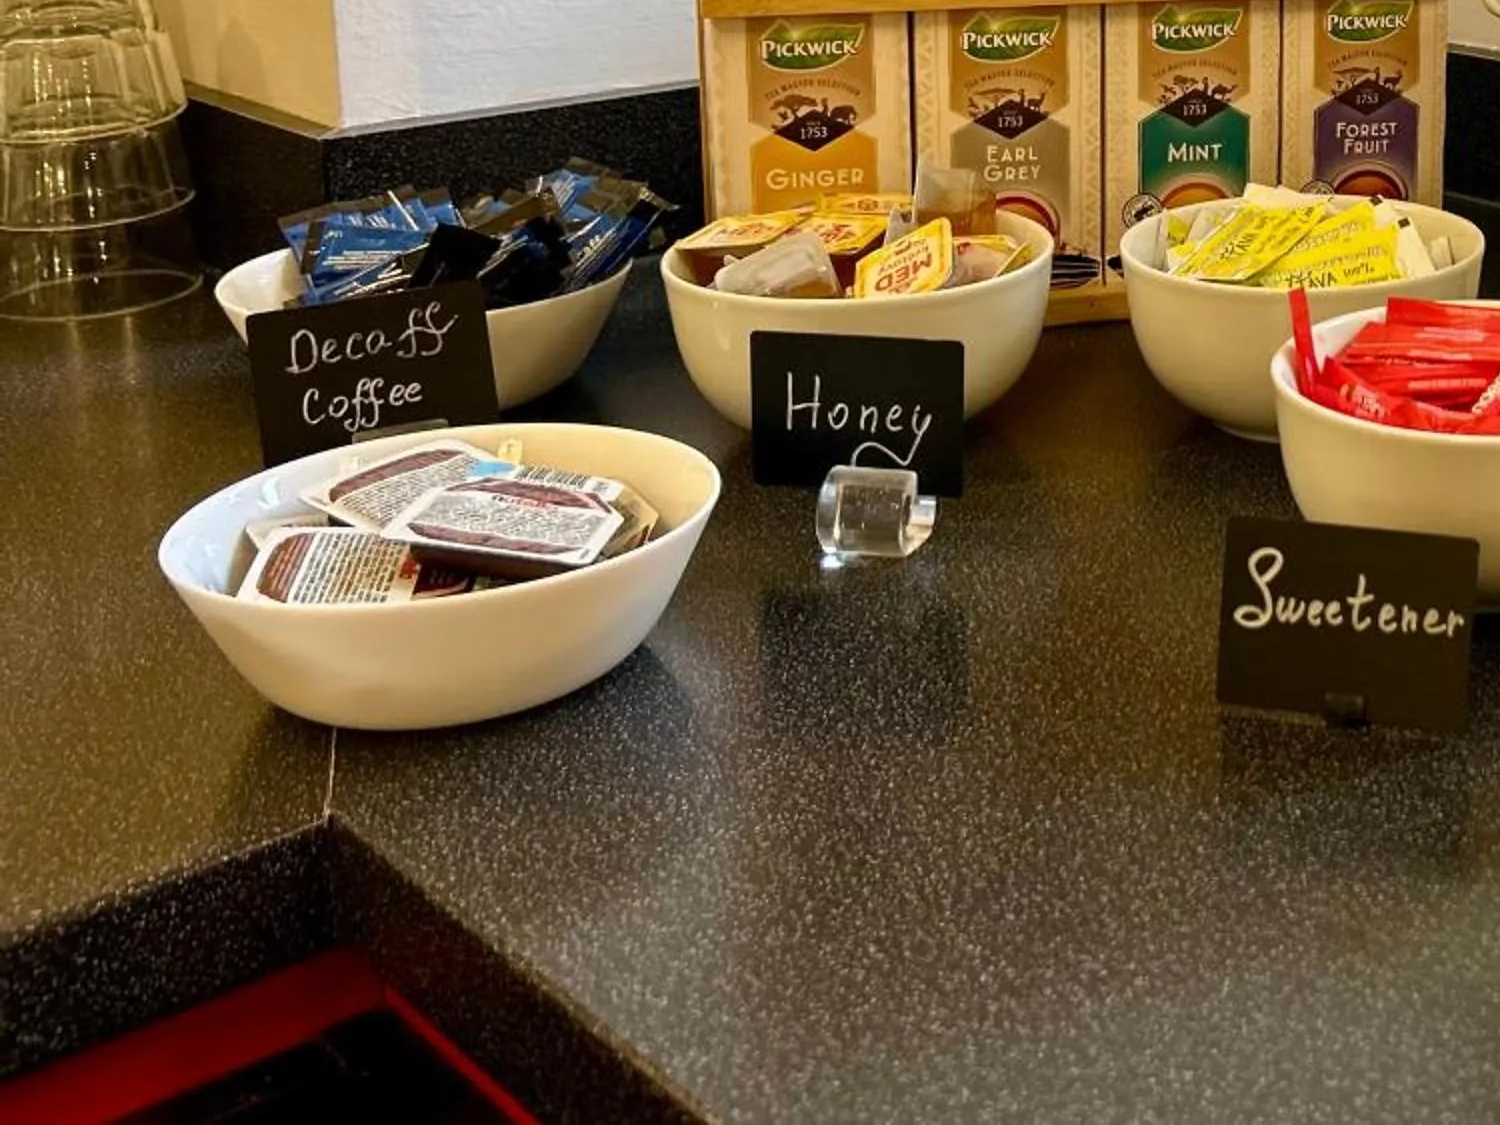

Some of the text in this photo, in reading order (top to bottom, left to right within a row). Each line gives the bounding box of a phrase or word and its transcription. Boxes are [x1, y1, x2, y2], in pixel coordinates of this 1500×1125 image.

[1151, 22, 1235, 41] PICKWICK
[1327, 13, 1407, 33] PICKWICK
[761, 39, 857, 60] PICKWICK
[962, 31, 1053, 50] PICKWICK
[800, 126, 829, 140] 1753
[1335, 121, 1398, 138] FOREST
[986, 145, 1038, 162] EARL
[1167, 142, 1223, 163] MINT
[1343, 138, 1390, 156] FRUIT
[765, 168, 865, 190] GINGER
[983, 163, 1041, 183] GREY
[285, 301, 459, 374] Decaff
[302, 378, 423, 432] Coffee
[785, 370, 932, 467] Honey
[1233, 545, 1465, 637] Sweetener
